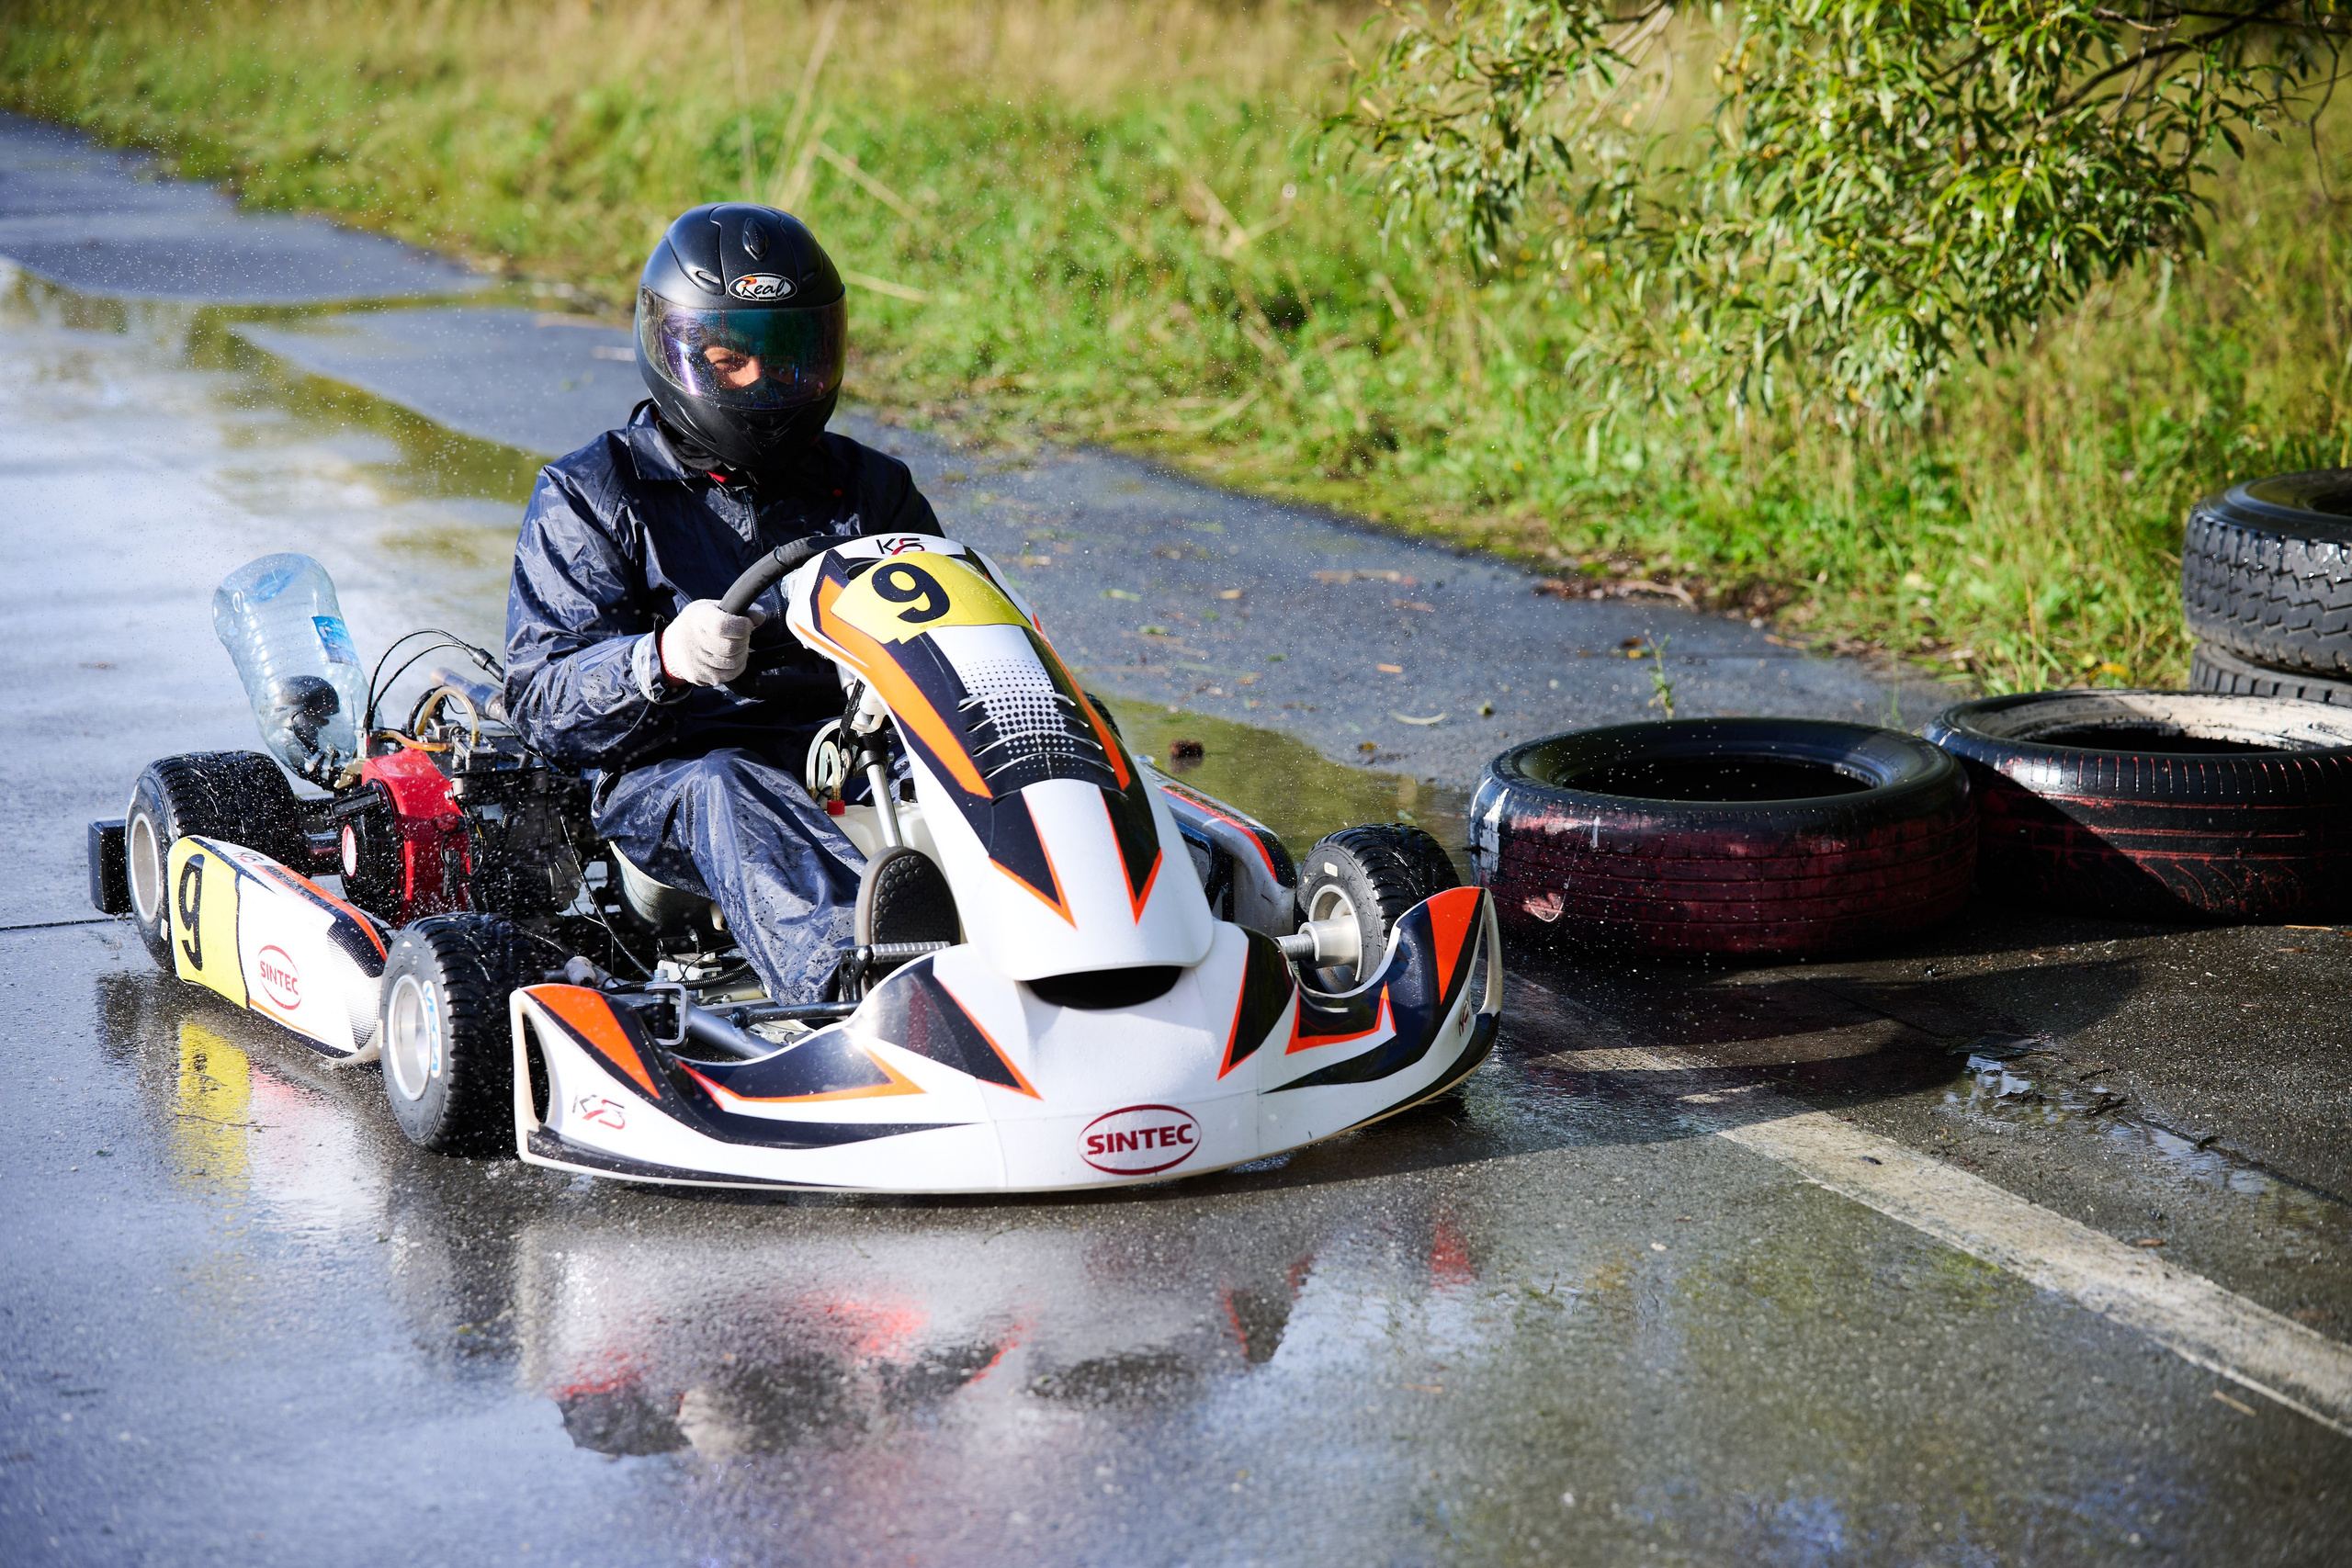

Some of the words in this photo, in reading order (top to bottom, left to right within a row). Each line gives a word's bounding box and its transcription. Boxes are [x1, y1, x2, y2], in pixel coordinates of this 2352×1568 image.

[740, 276, 786, 299] Real
[871, 562, 951, 624] 9
[178, 853, 205, 972] 9
[259, 960, 300, 996] SINTEC
[1086, 1123, 1194, 1156] SINTEC
